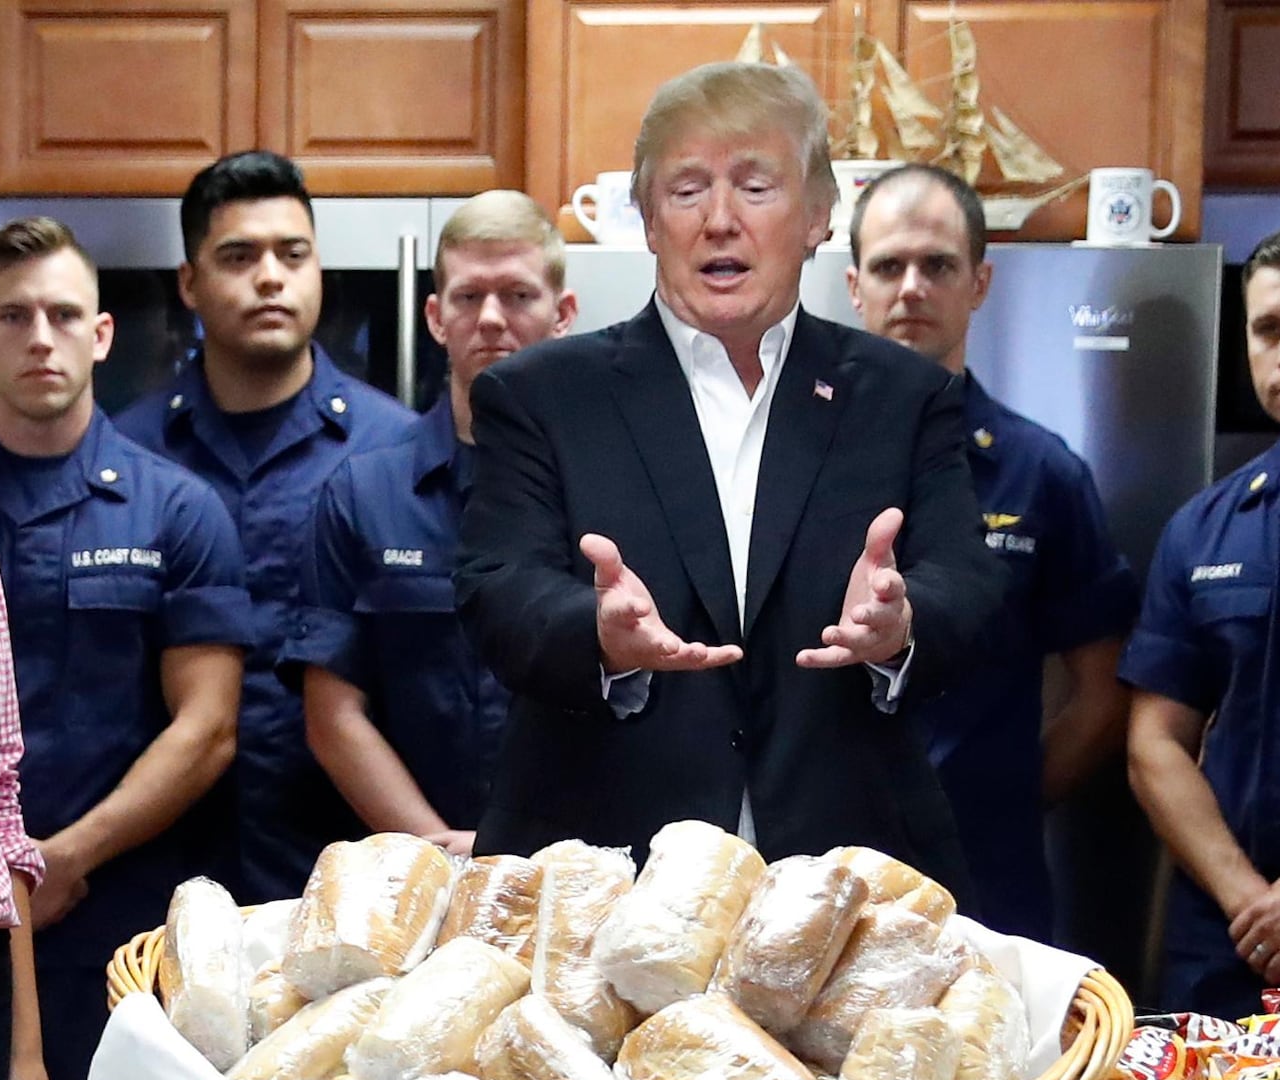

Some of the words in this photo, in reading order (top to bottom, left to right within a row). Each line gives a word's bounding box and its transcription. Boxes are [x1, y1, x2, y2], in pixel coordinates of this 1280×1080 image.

[72, 550, 94, 568] U.S.
[94, 548, 130, 566] COAST
[130, 548, 162, 568] GUARD
